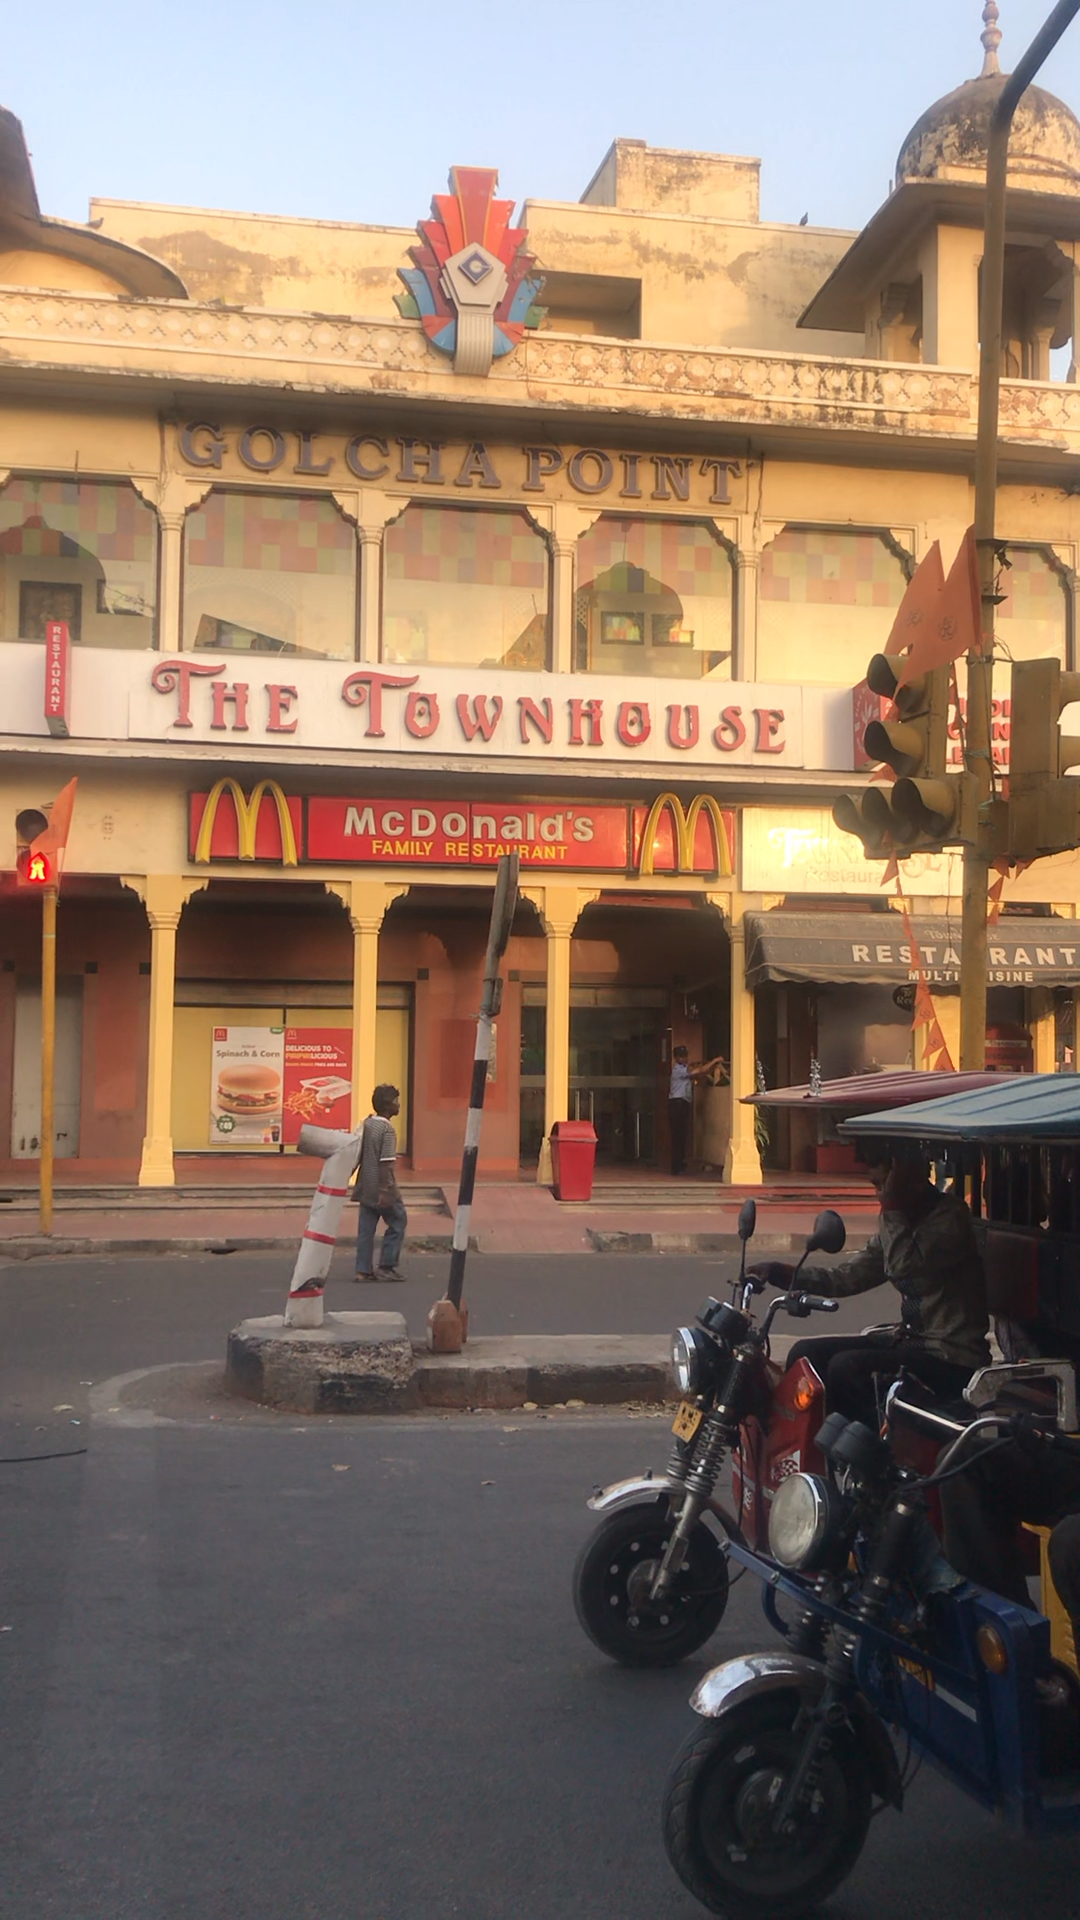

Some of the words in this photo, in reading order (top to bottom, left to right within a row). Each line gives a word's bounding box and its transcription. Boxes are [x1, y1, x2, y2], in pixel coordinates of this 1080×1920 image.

[178, 421, 502, 488] GOLCHA
[522, 446, 742, 505] POINT
[50, 626, 62, 712] RESTAURANT
[151, 660, 298, 733] THE
[342, 671, 786, 754] TOWNHOUSE
[343, 806, 594, 843] McDonald's
[372, 840, 434, 856] FAMILY
[445, 842, 568, 860] RESTAURANT
[852, 945, 1076, 965] RESTARANT
[908, 970, 959, 982] MULTI
[989, 972, 1034, 982] ISINE
[216, 1050, 250, 1059] Spinach
